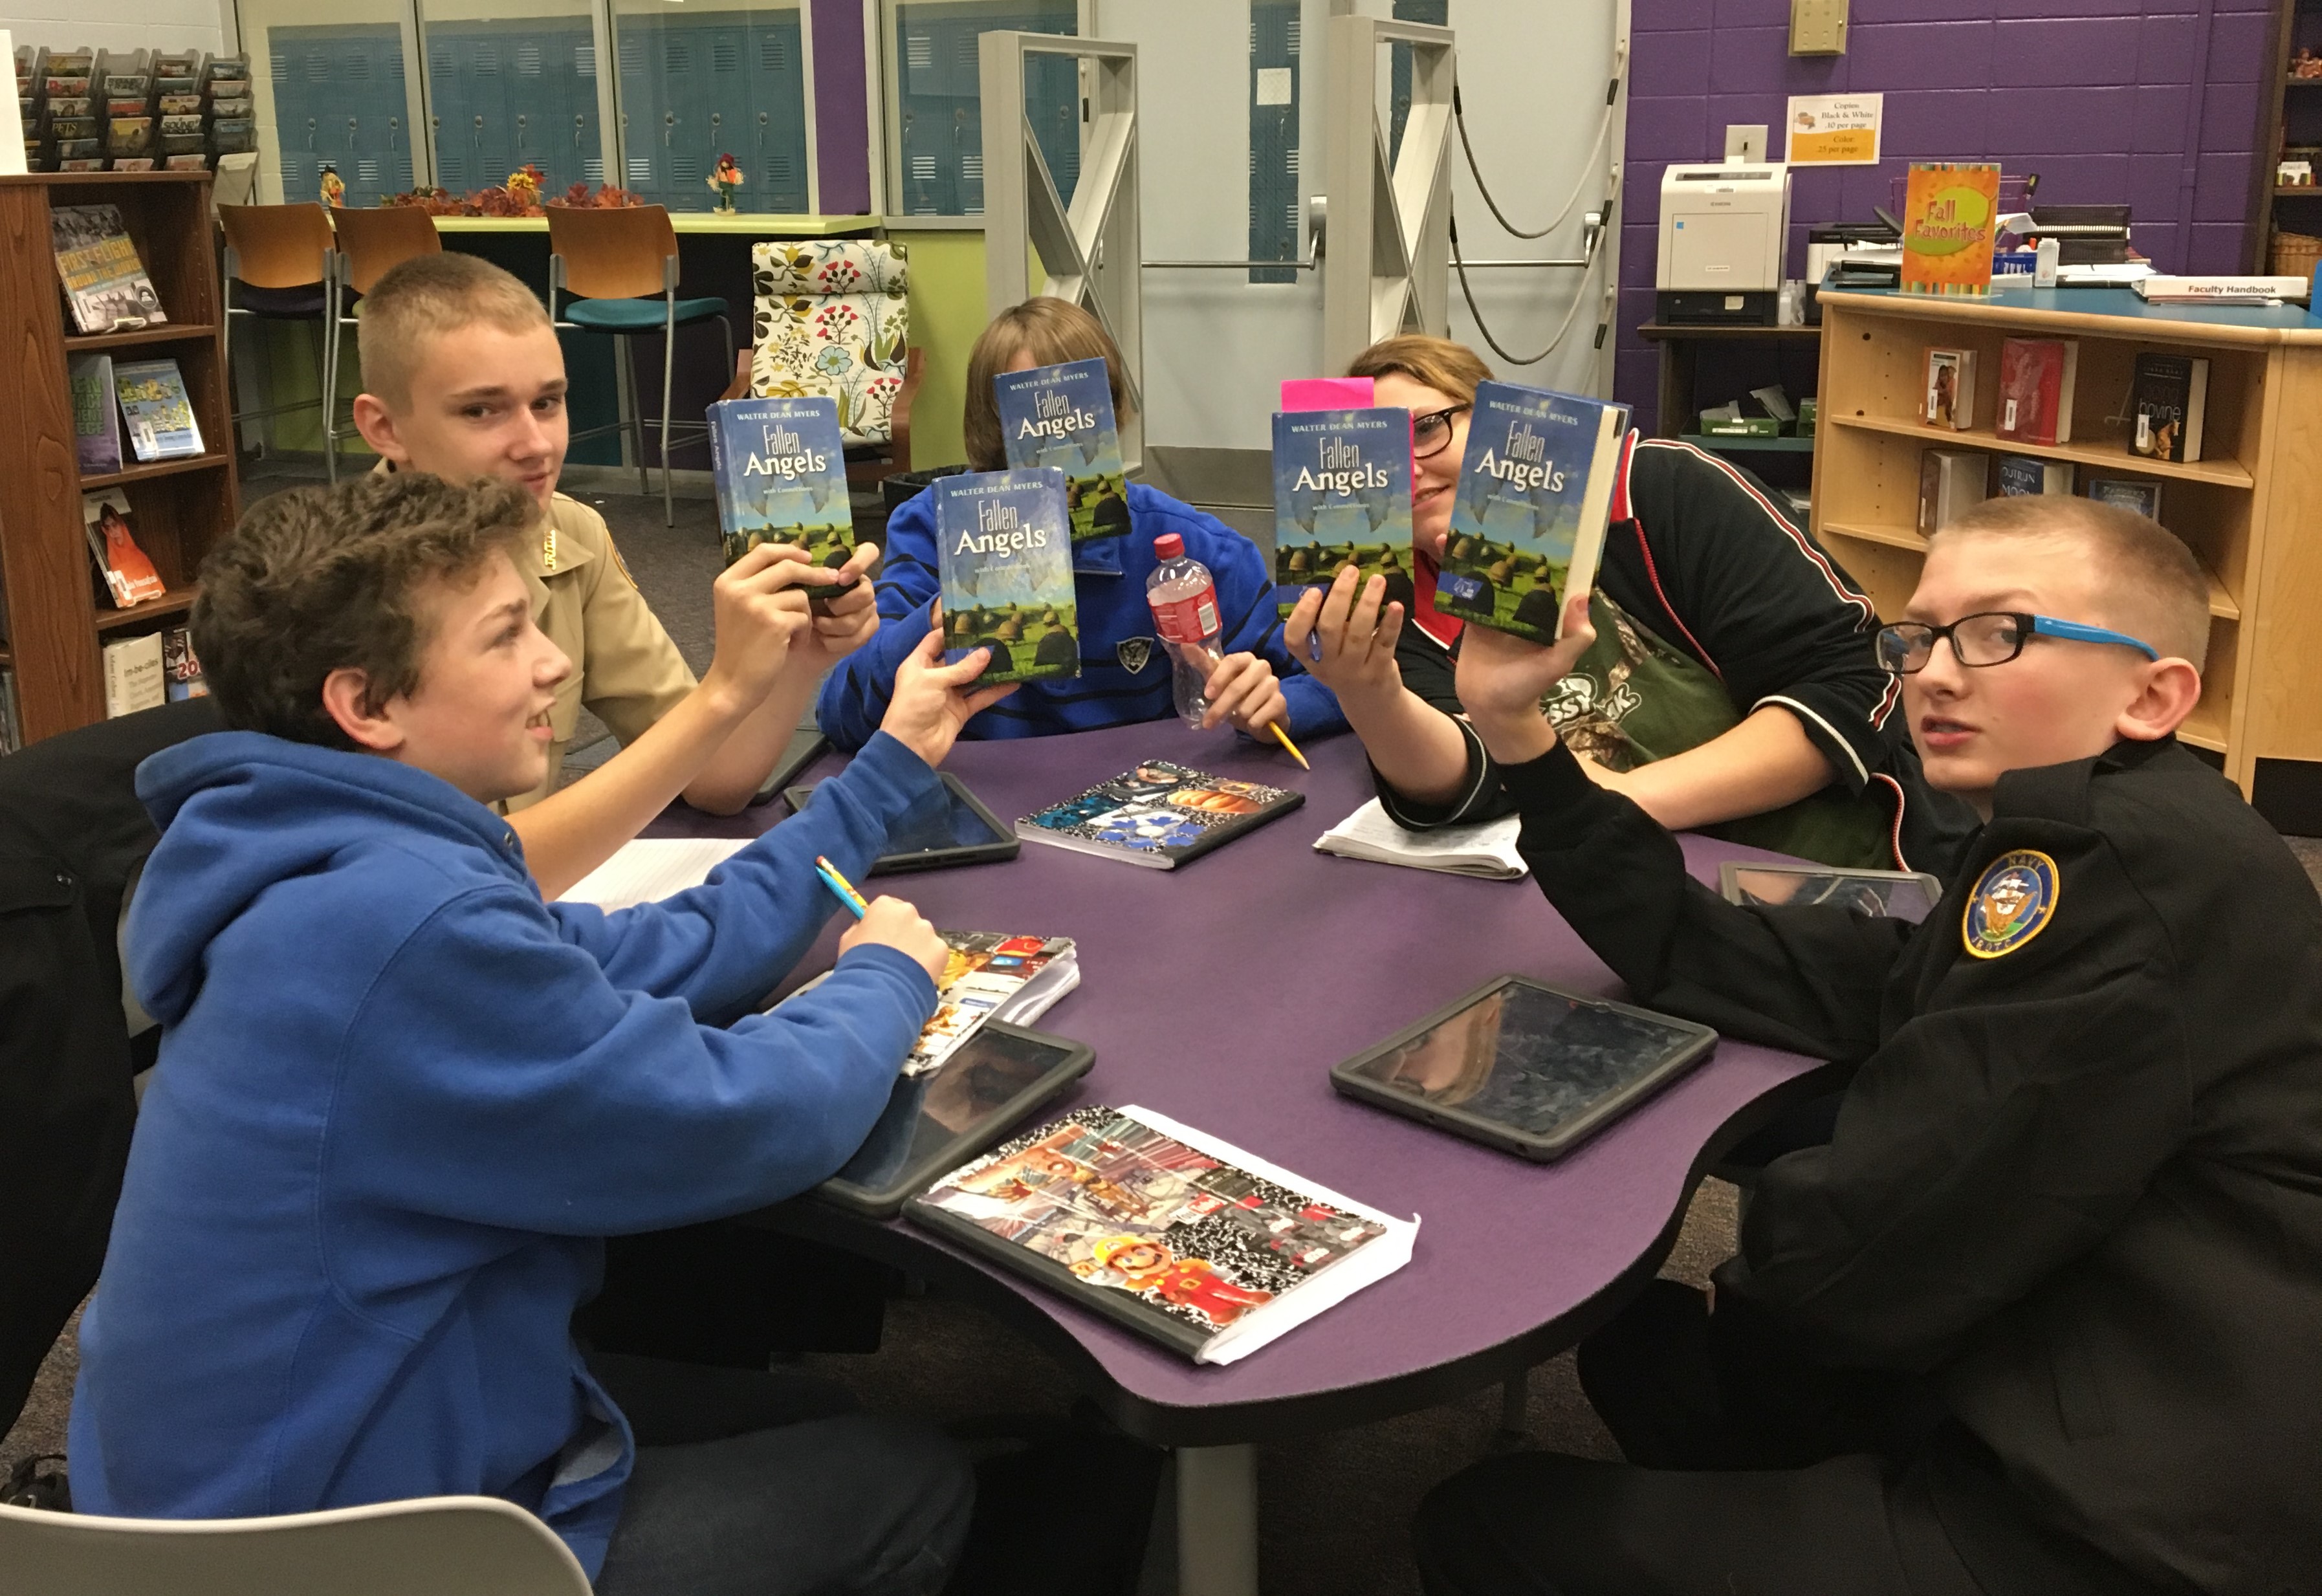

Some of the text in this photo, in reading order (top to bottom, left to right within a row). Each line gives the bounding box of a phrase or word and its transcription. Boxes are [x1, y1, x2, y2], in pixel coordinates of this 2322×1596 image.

[52, 122, 78, 131] PETS
[1828, 146, 1839, 155] per
[1841, 146, 1859, 155] page
[1927, 199, 1956, 223] Fall
[1914, 219, 1986, 241] Favorites
[58, 249, 94, 276] FIRST
[2188, 285, 2276, 294] Faculty Handbook
[1009, 372, 1089, 391] WALTER DEAN MYERS
[736, 412, 769, 421] WALTER
[794, 410, 820, 418] MYERS
[1034, 389, 1070, 419] Fallen
[1489, 400, 1579, 426] WALTER DEAN MYERS
[2139, 398, 2182, 421] bovine
[1017, 408, 1095, 440] Angels
[1291, 421, 1388, 433] WALTER DEAN MYERS
[763, 424, 800, 455] Fallen
[1505, 420, 1546, 463] Fallen
[743, 448, 827, 481] Angels
[1319, 436, 1359, 470] Fallen
[1292, 462, 1388, 497] Angels
[1474, 447, 1565, 492] Angels
[950, 481, 1044, 497] WALTER DEAN MYERS
[978, 499, 1018, 532] Fallen
[953, 522, 1047, 558] Angels
[2008, 855, 2045, 871] NAVY
[1971, 936, 2012, 952] JROTC
